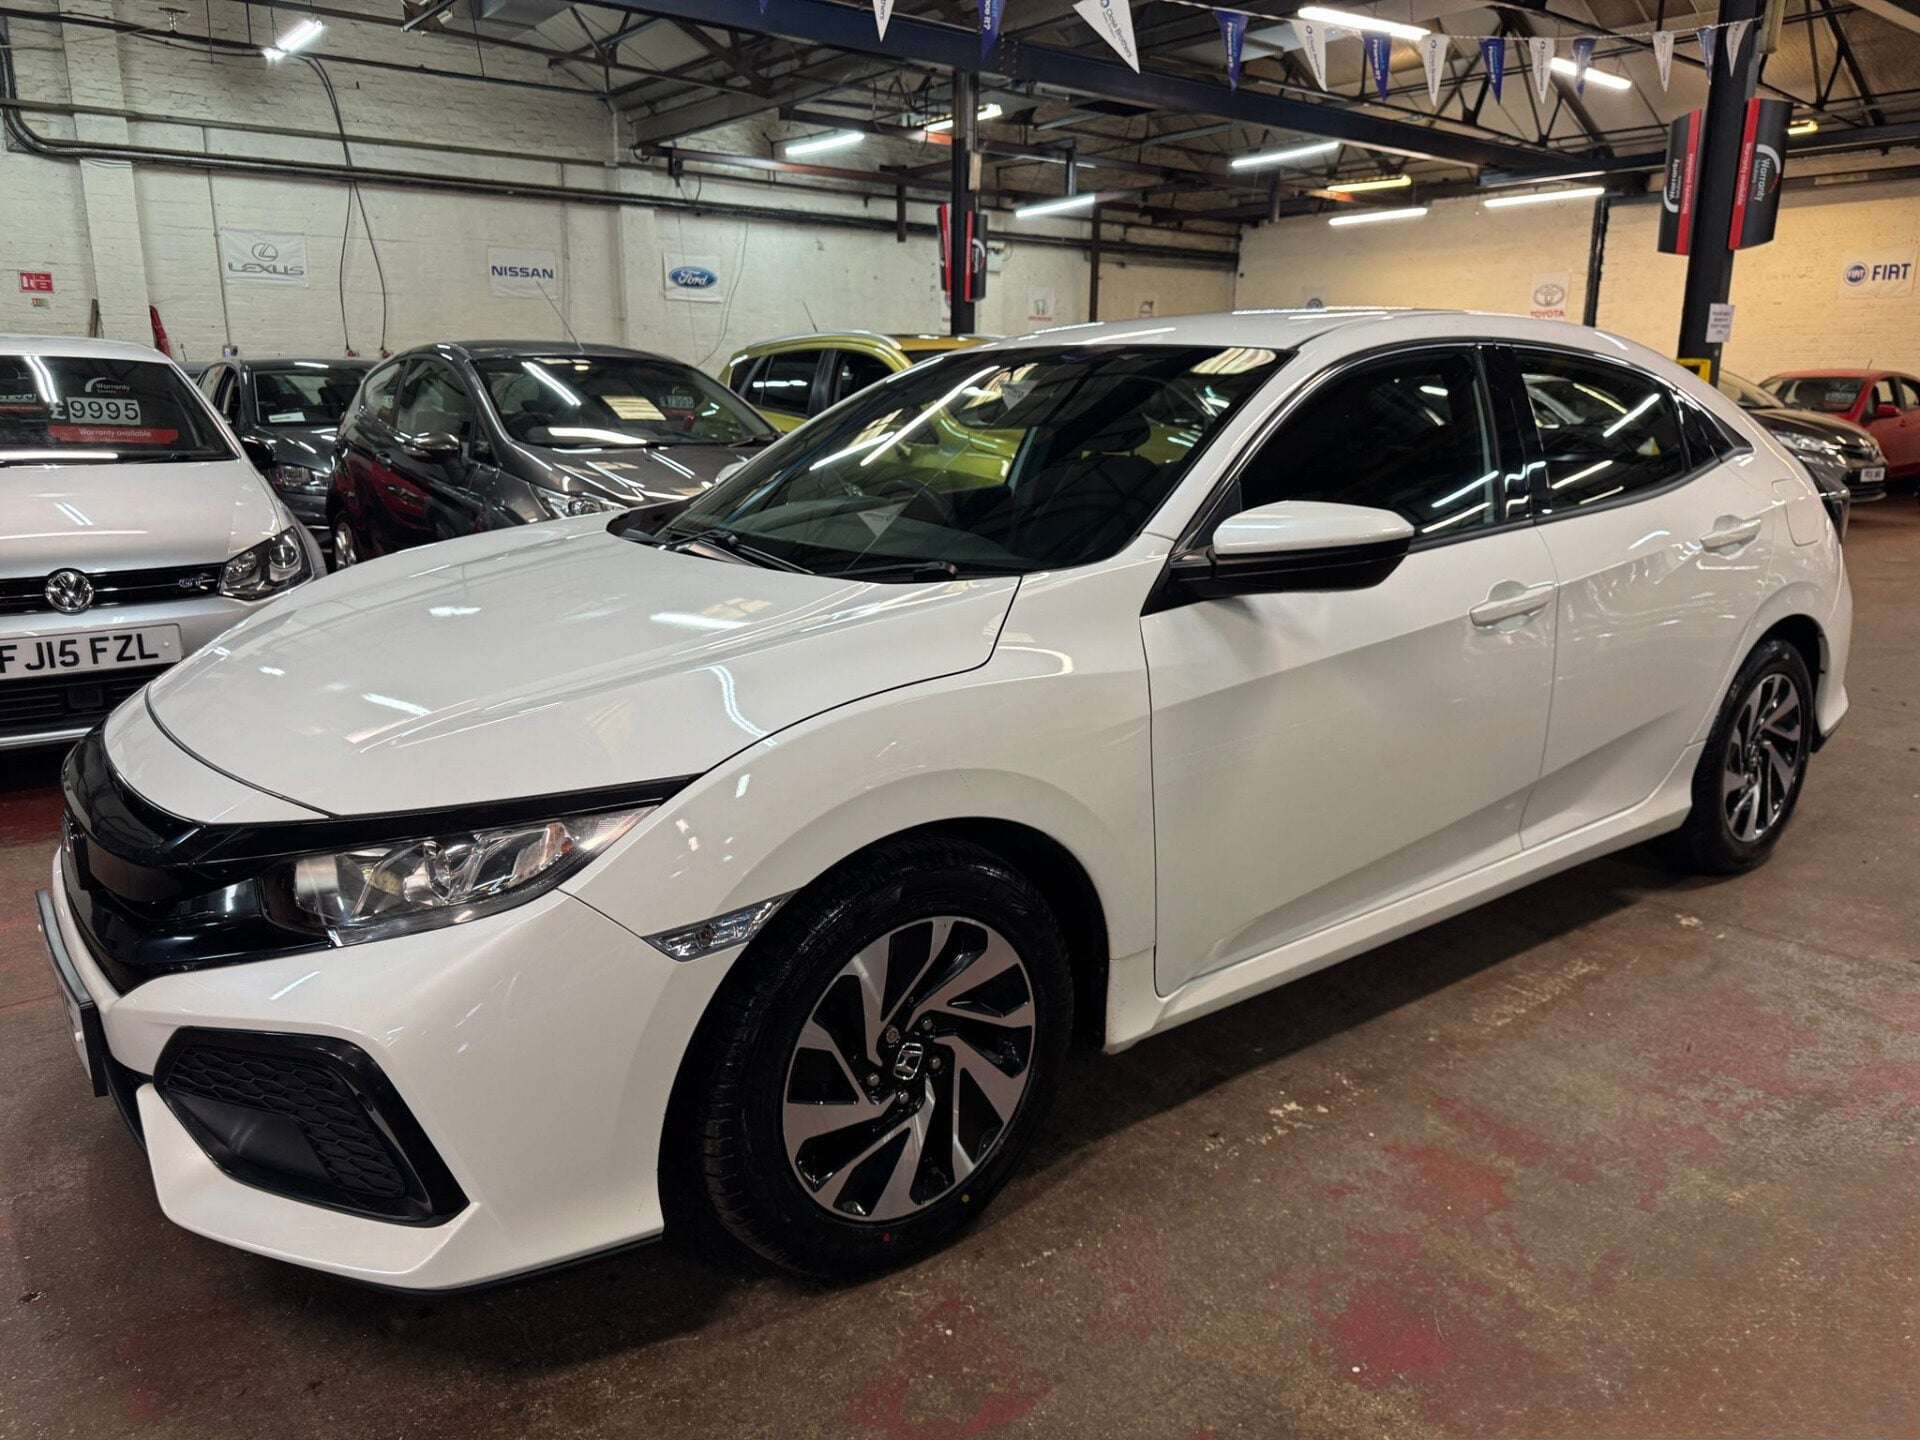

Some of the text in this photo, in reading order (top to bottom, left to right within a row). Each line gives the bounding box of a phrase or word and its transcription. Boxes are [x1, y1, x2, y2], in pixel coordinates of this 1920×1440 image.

[1668, 158, 1680, 200] Warranty
[1754, 158, 1771, 202] Warranty
[228, 262, 304, 276] LEXUS
[491, 265, 553, 280] NISSAN
[678, 270, 709, 286] Ford
[1871, 263, 1911, 281] FIAT
[0, 633, 158, 674] FJ15 FZL
